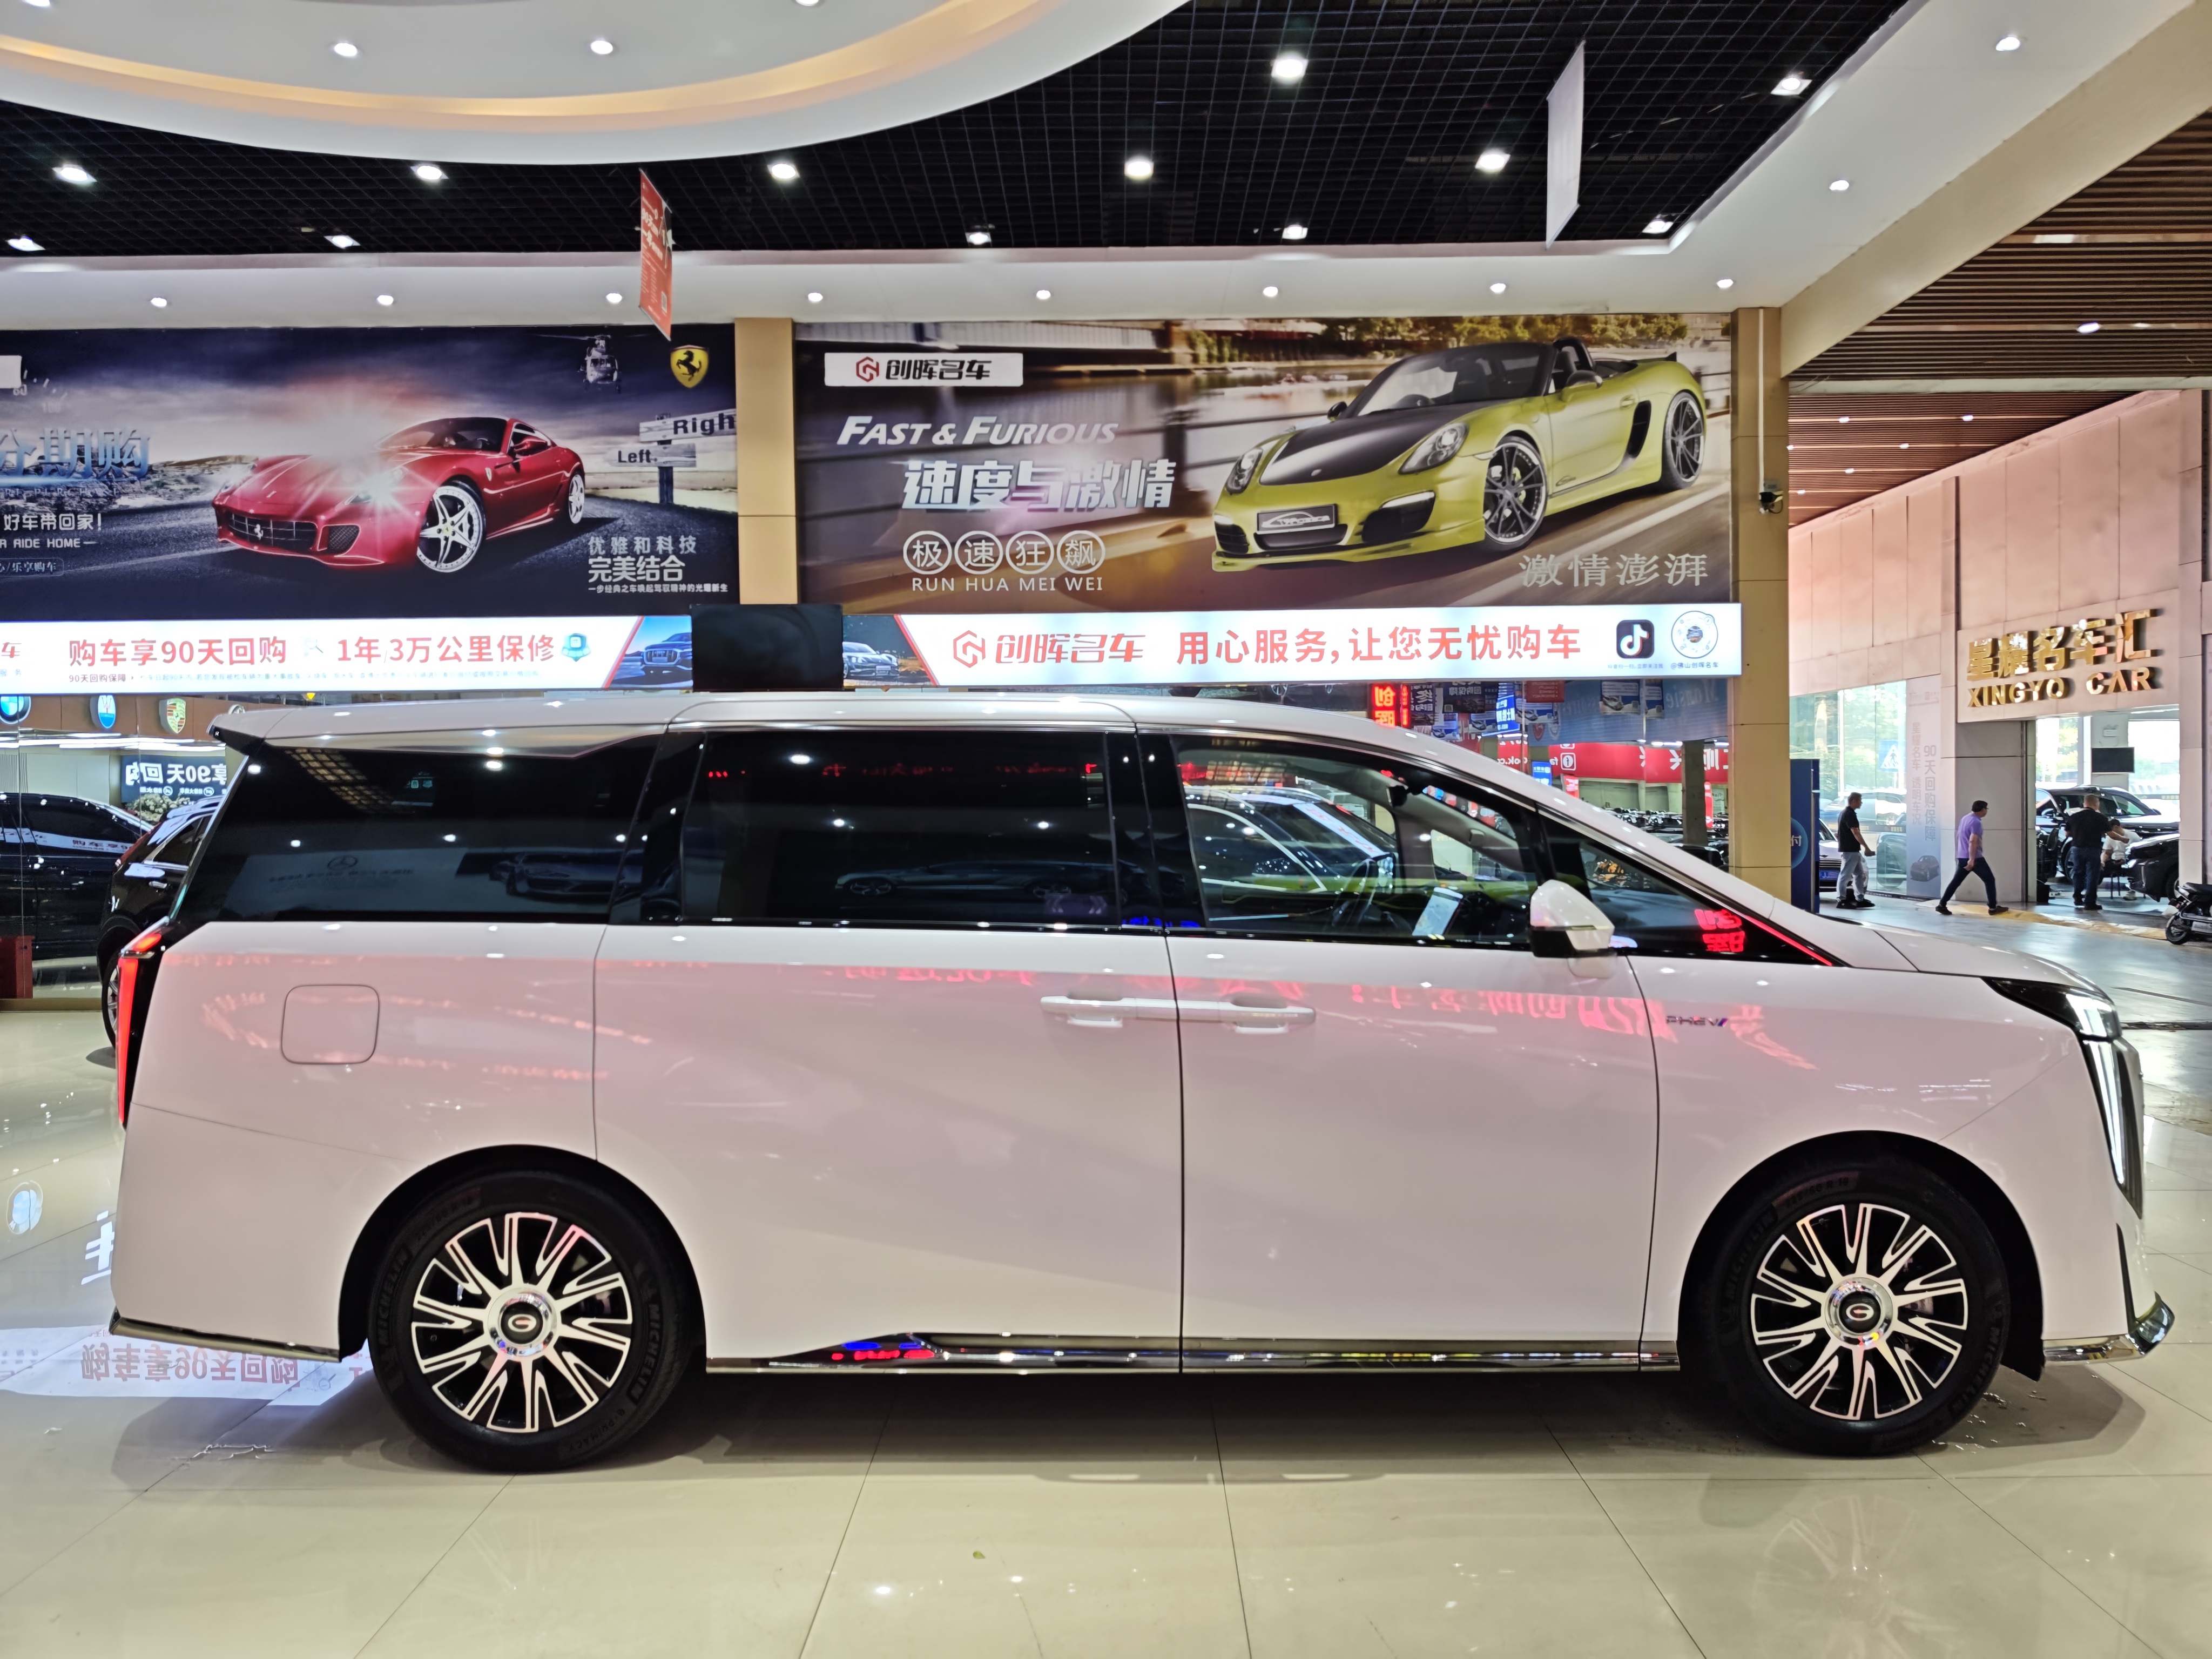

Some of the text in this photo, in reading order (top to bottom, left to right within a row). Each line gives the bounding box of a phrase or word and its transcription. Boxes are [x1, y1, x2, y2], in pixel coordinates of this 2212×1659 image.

[885, 359, 992, 380] 创晖名车
[673, 413, 735, 436] Righ
[837, 416, 1118, 445] FAST & FURIOUS
[901, 459, 1176, 512] 速度与激情
[47, 538, 81, 548] HOME
[588, 535, 697, 555] 优雅和科技
[912, 539, 1096, 568] 极速狂飙
[588, 555, 686, 583] 完美结合
[1519, 553, 1708, 588] 激情澎湃
[912, 577, 1103, 592] RUN HUA MEI WEI
[69, 636, 286, 667] 购车享90天回购
[995, 633, 1145, 664] 创晖名车
[1967, 609, 2153, 682] 星耀名车汇
[69, 673, 126, 683] 90天回购保障
[1967, 677, 2069, 707] XINGYO
[2086, 667, 2153, 695] CAR
[1911, 776, 1922, 825] 透明车况
[1923, 745, 1937, 841] 90天回购保障
[631, 1304, 662, 1404] MICHELIN
